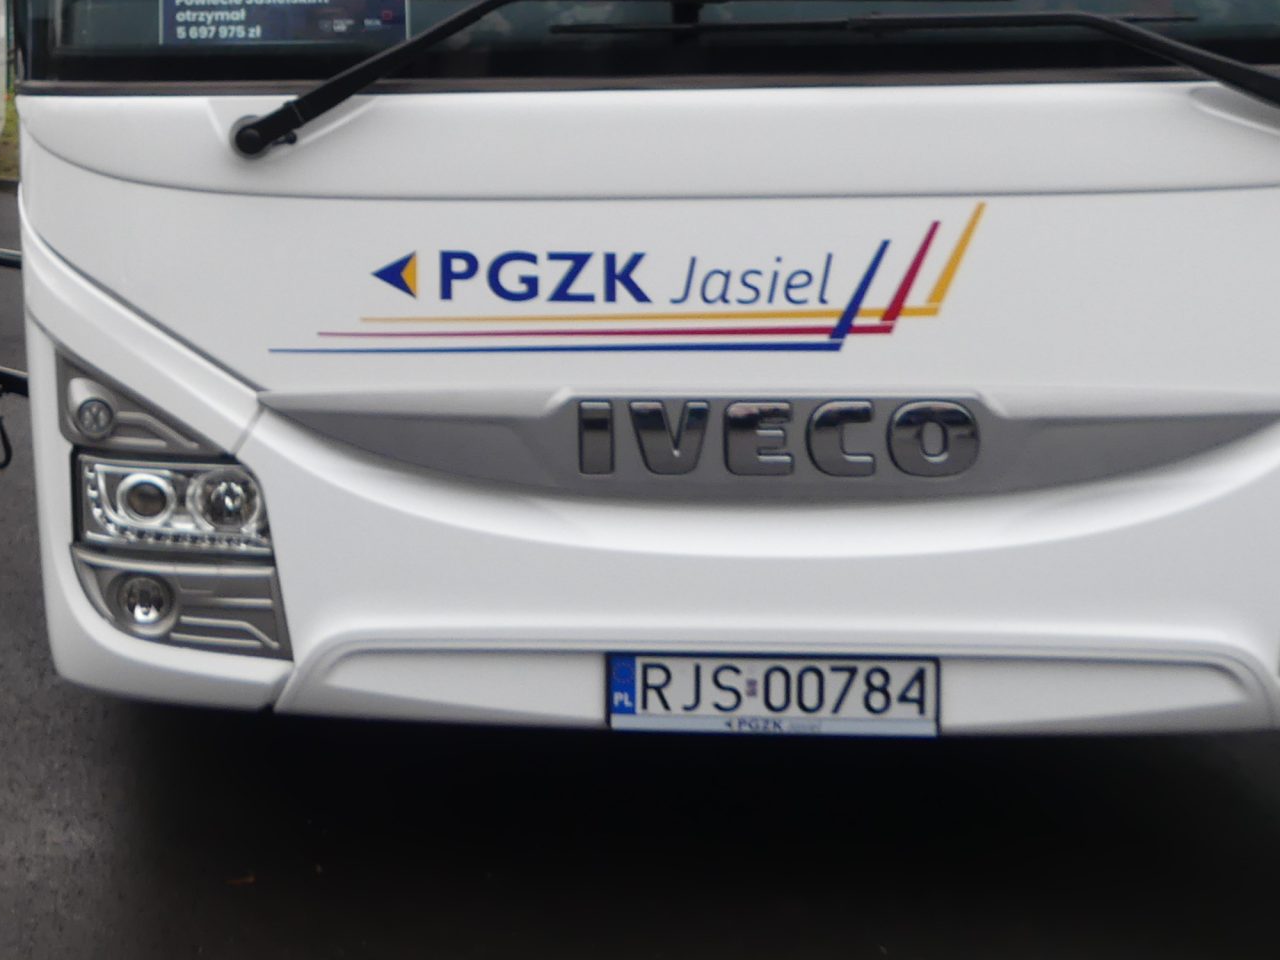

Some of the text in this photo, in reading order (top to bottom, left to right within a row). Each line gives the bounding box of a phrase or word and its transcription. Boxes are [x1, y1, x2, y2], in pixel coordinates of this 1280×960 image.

[176, 9, 246, 24] otrzymał
[438, 249, 834, 306] PGZK Jasiel
[576, 398, 981, 477] IVECO
[613, 662, 927, 716] PL RJS 00784
